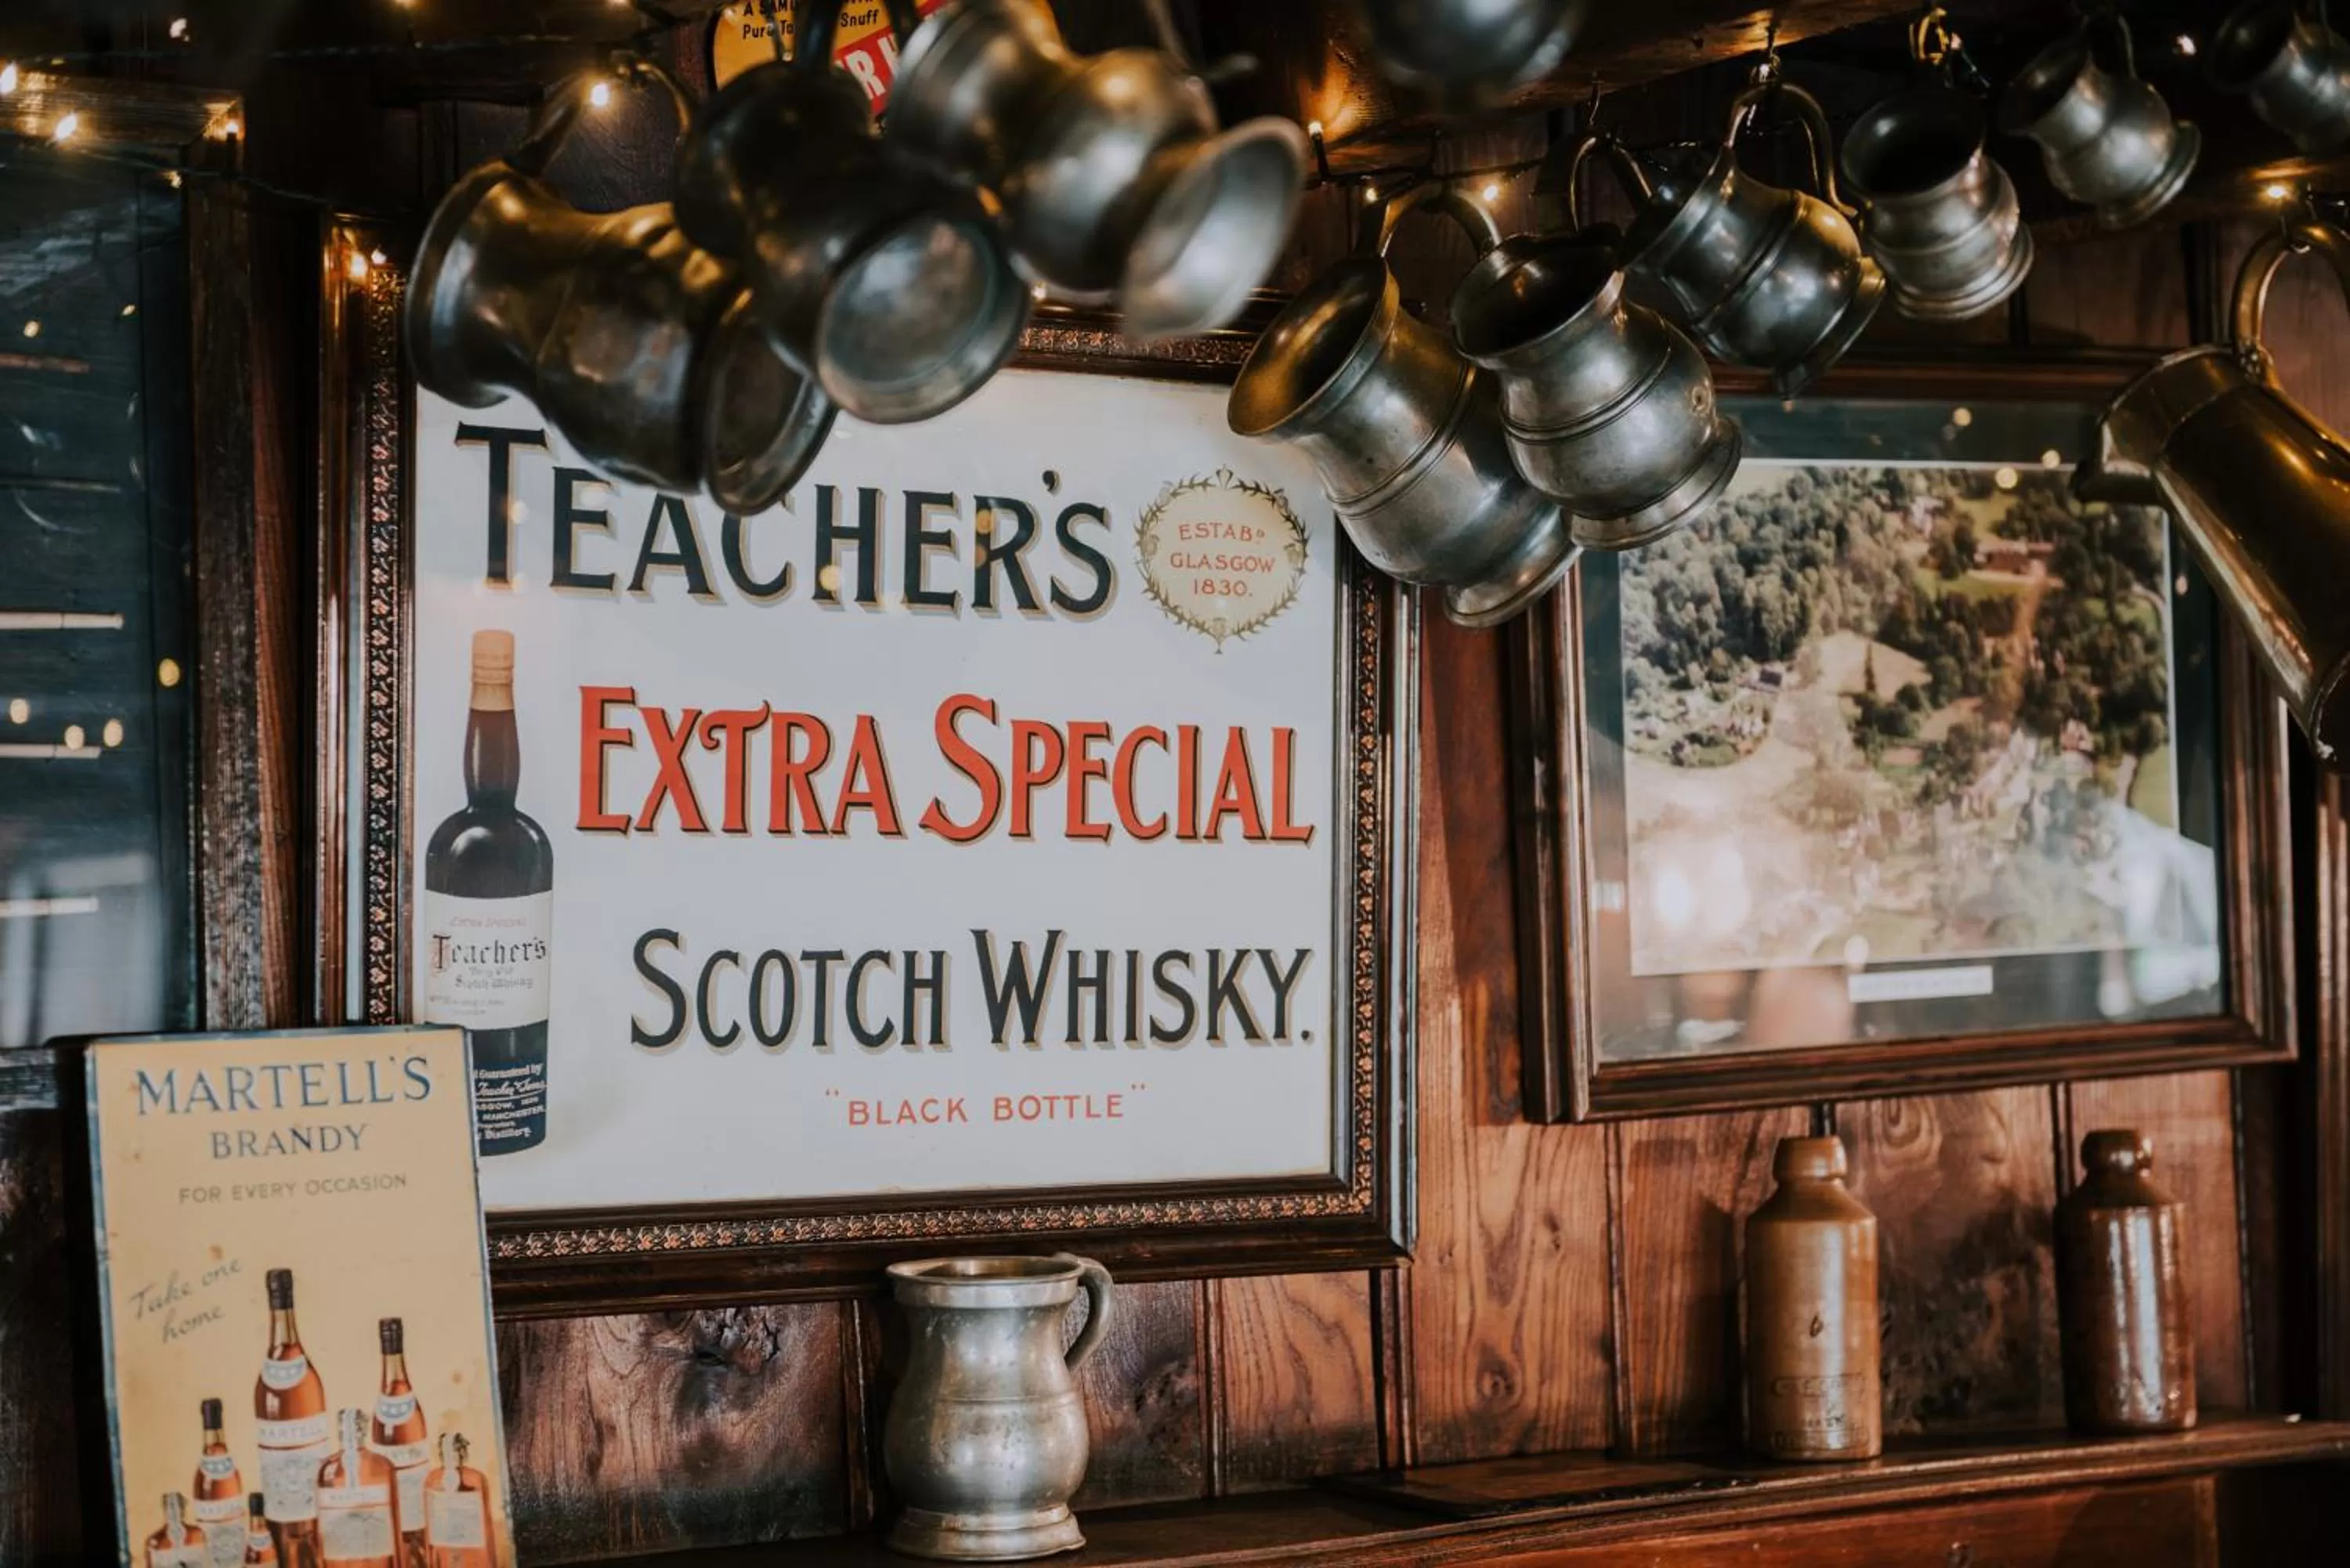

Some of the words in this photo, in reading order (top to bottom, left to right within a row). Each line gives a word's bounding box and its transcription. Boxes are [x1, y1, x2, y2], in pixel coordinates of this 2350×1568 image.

[841, 9, 879, 27] Snuff
[454, 421, 1116, 616] TEACHER'S
[1170, 551, 1276, 573] GLASGOW
[1194, 579, 1253, 597] 1830.
[575, 685, 909, 840] EXTRA
[918, 693, 1317, 849] SPECIAL
[432, 934, 547, 970] Teacher's
[631, 928, 953, 1052] SCOTCH
[968, 927, 1314, 1050] WHISKY.
[134, 1056, 432, 1117] MARTELL'S
[212, 1124, 369, 1159] BRANDY
[178, 1187, 222, 1205] FOR
[231, 1182, 297, 1201] EVERY
[306, 1174, 407, 1197] OCCASION
[128, 1269, 193, 1321] Take
[162, 1304, 226, 1344] home
